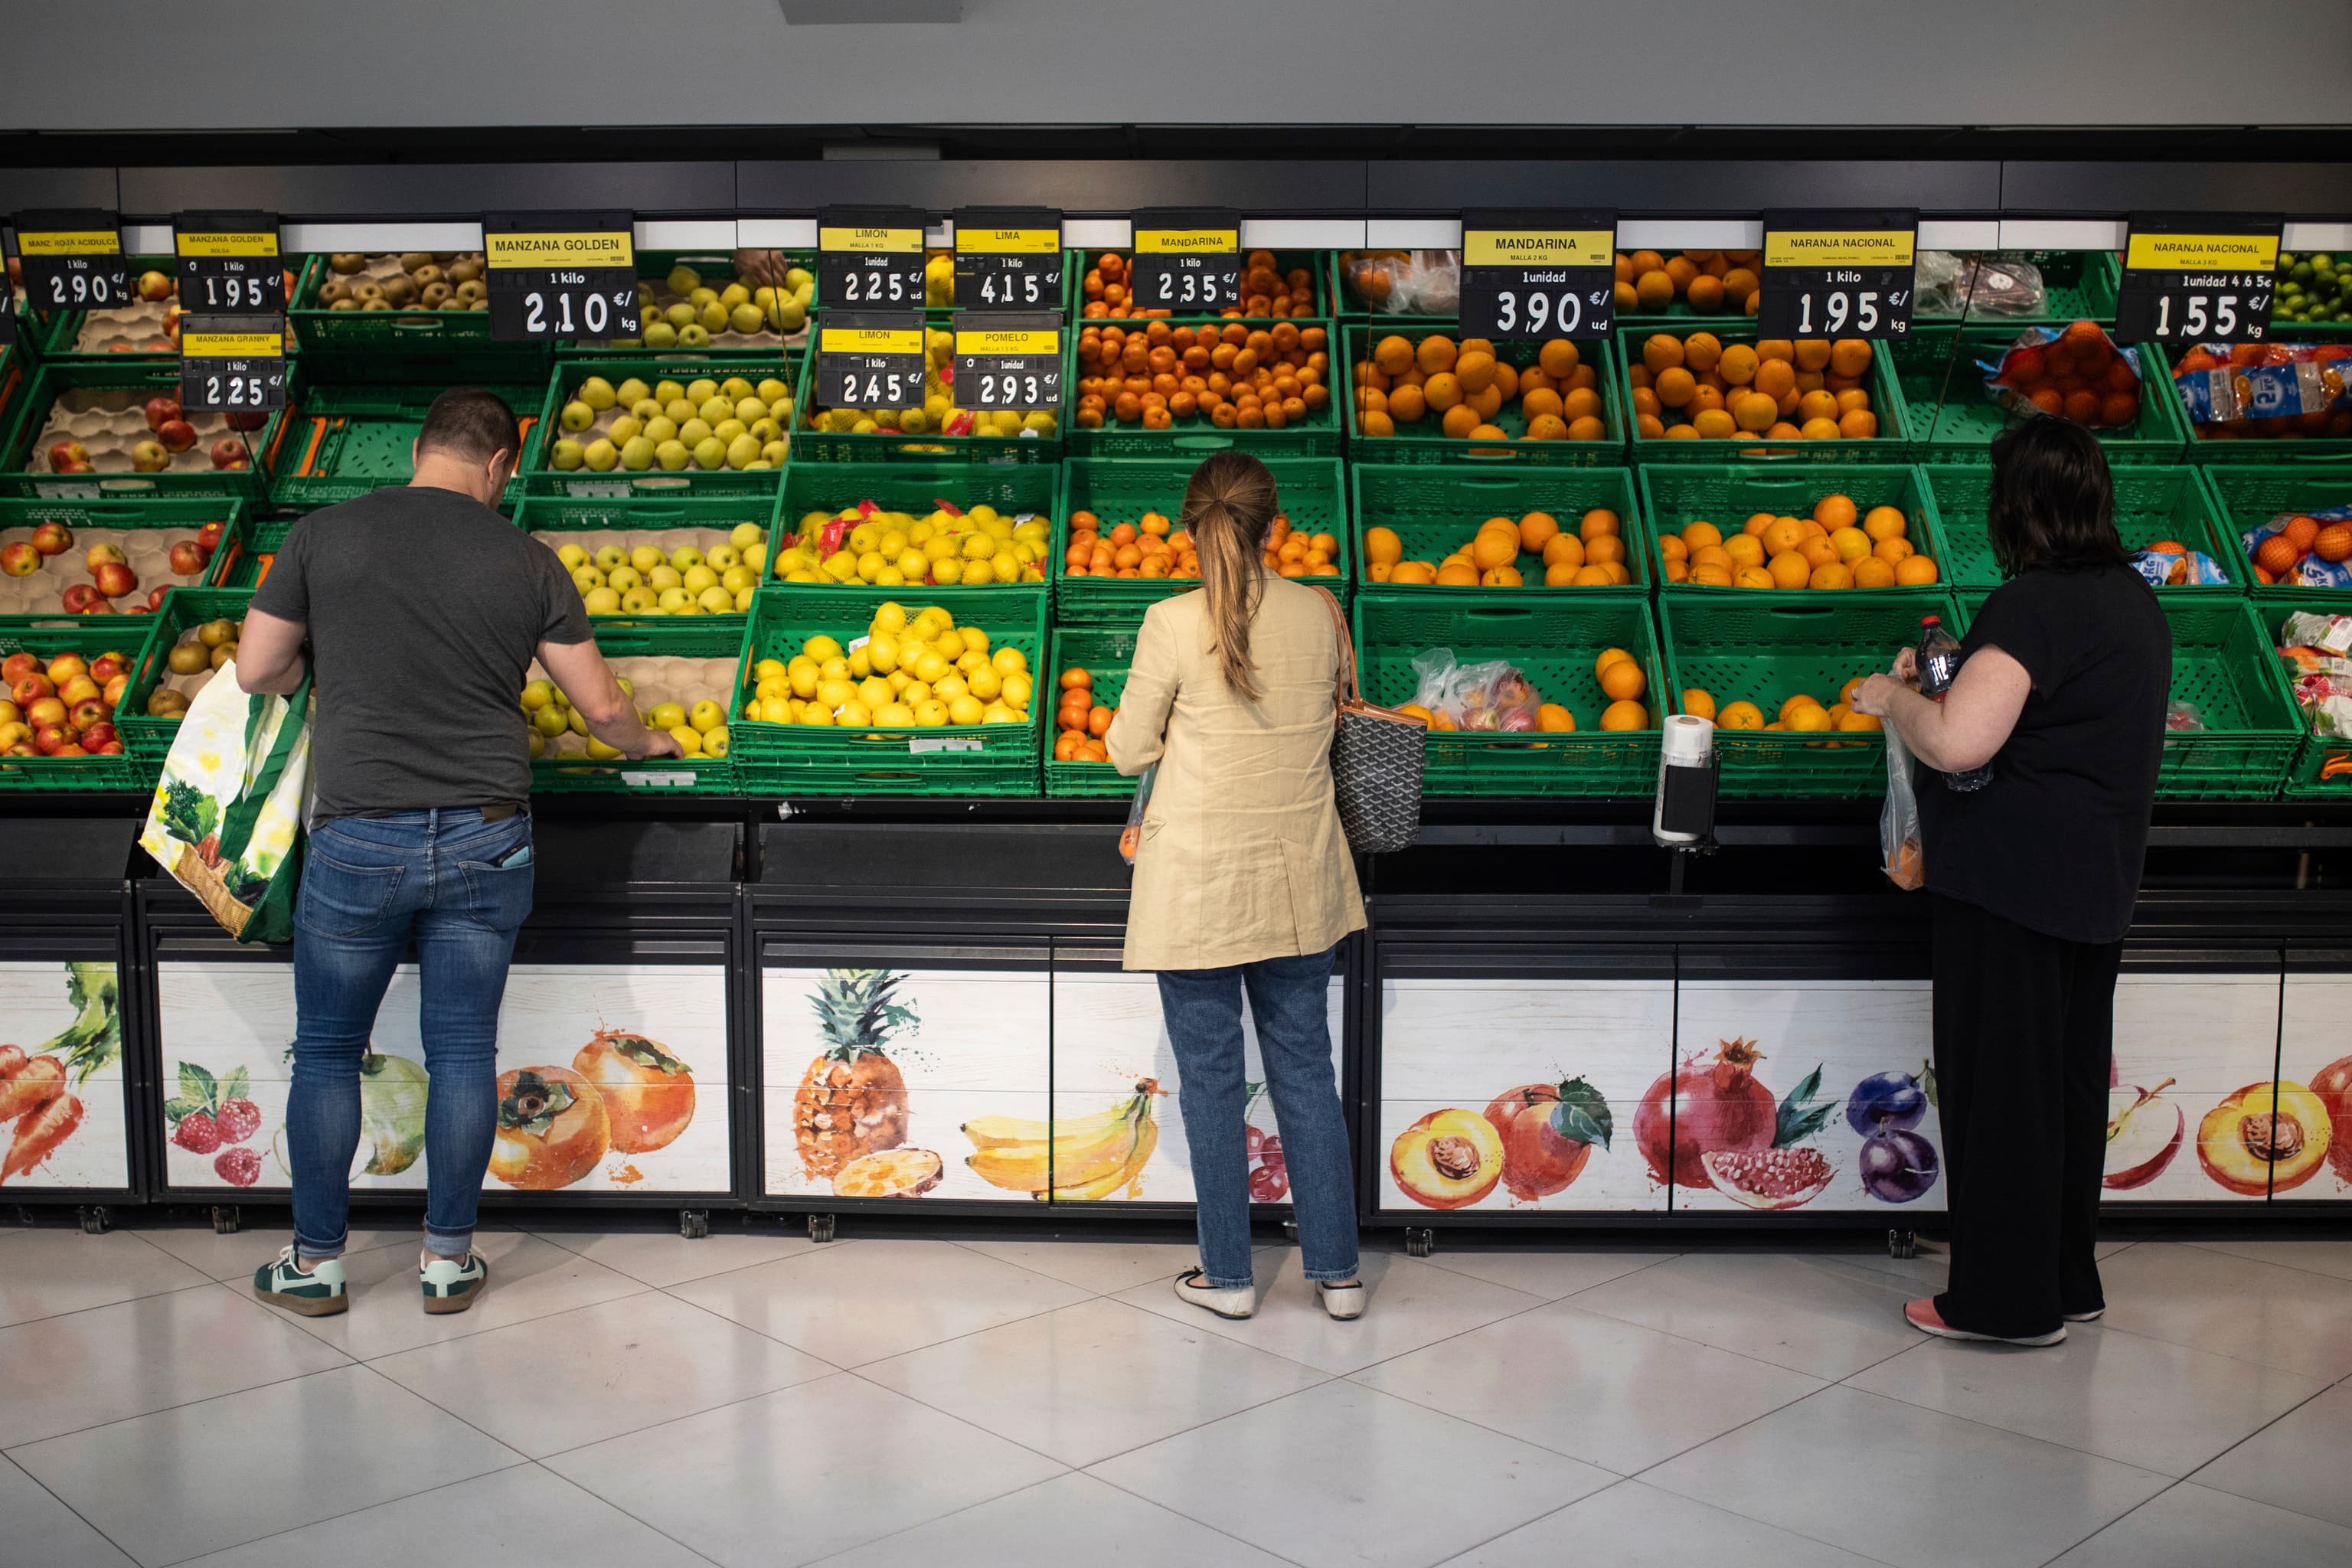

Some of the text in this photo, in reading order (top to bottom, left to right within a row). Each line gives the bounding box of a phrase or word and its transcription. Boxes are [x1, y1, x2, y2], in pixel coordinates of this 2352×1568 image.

[495, 239, 619, 251] MANZANA GOLDEN
[1161, 237, 1223, 247] MANDARINA
[1495, 239, 1577, 250] MANDARINA
[1791, 238, 1896, 248] NARANJA NACIONAL
[2154, 243, 2260, 253] NARANJA NACIONAL
[67, 260, 88, 269] 1 kilo
[224, 263, 228, 271] 1
[230, 262, 244, 271] kilo
[1001, 258, 1023, 268] 1 kilo
[1180, 258, 1201, 267] 1 kilo
[550, 273, 585, 284] 1 kilo
[1826, 271, 1862, 283] 1 kilo
[50, 275, 108, 303] 2,90
[206, 278, 263, 307] 1,95
[845, 272, 903, 301] 2,25
[981, 274, 1039, 303] 4,15
[1159, 273, 1217, 303] 2,35
[116, 290, 128, 300] kg
[910, 291, 922, 299] ud
[1226, 290, 1237, 301] kg
[524, 292, 608, 333] 2,10
[1497, 291, 1581, 333] 3,90
[1798, 292, 1878, 333] 1,95
[2155, 296, 2238, 337] 1,55
[621, 317, 636, 332] kg
[1592, 319, 1608, 331] ud
[1891, 318, 1906, 333] kg
[859, 331, 890, 339] LIMON
[2247, 324, 2262, 338] kg
[233, 361, 247, 371] kilo
[865, 359, 886, 368] 1 kilo
[207, 377, 263, 406] 2,25
[844, 374, 902, 403] 2,45
[981, 375, 1038, 404] 2,93
[1046, 394, 1058, 402] ud
[2143, 560, 2156, 574] KG
[2305, 567, 2325, 579] 5
